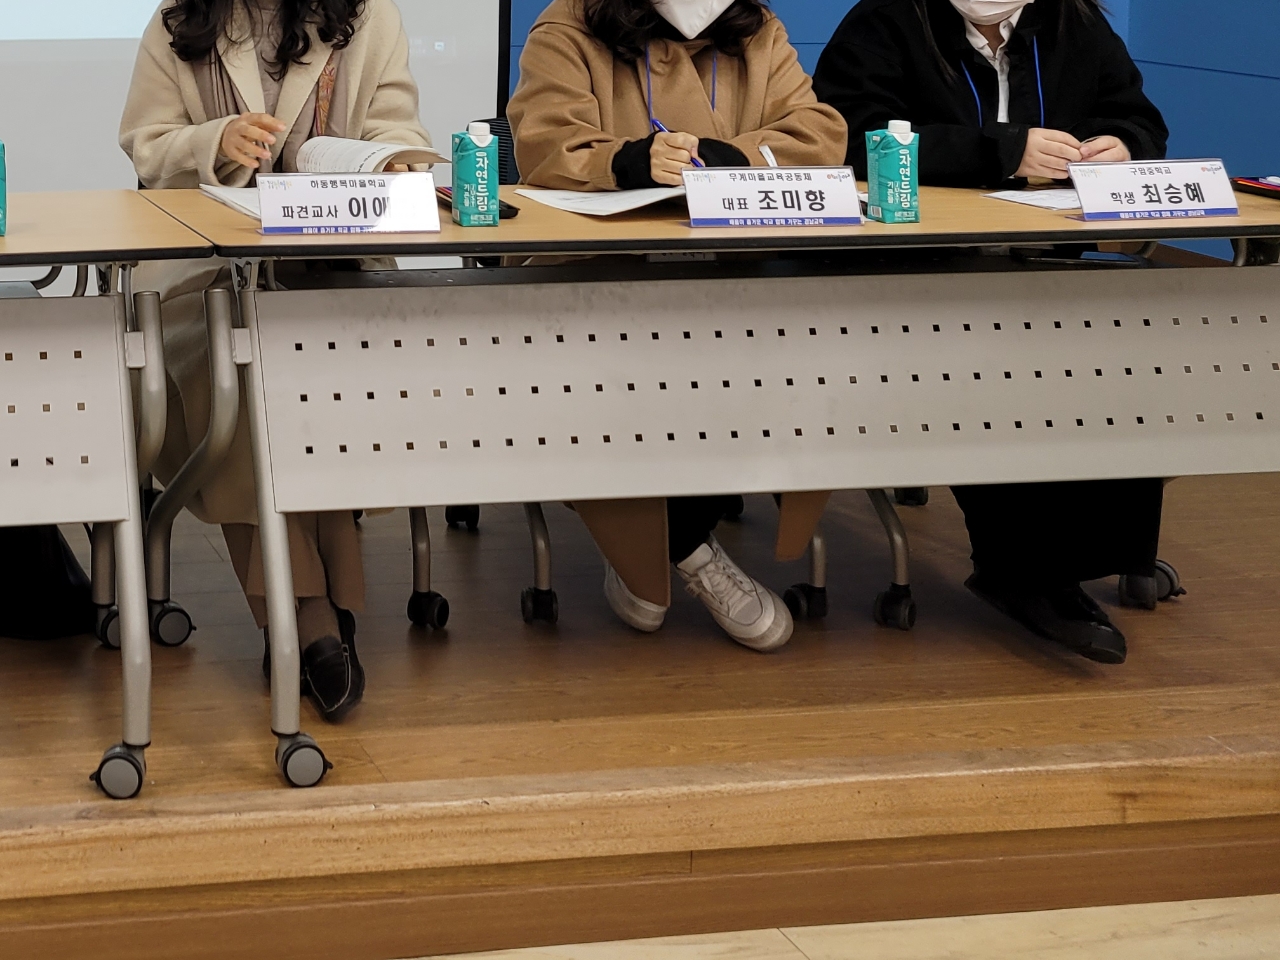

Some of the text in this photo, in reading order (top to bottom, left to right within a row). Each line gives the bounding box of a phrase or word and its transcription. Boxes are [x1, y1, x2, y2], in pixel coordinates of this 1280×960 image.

[729, 172, 813, 182] 무계마을교육공동체
[899, 154, 912, 208] 자연드림
[1129, 166, 1172, 175] 구암중학교
[310, 179, 386, 189] 하동행복마을학교
[476, 157, 489, 211] 자연드림
[1110, 182, 1206, 205] 학생 최승혜
[282, 197, 392, 219] 파견교사 이애
[722, 189, 826, 211] 대표 조미향
